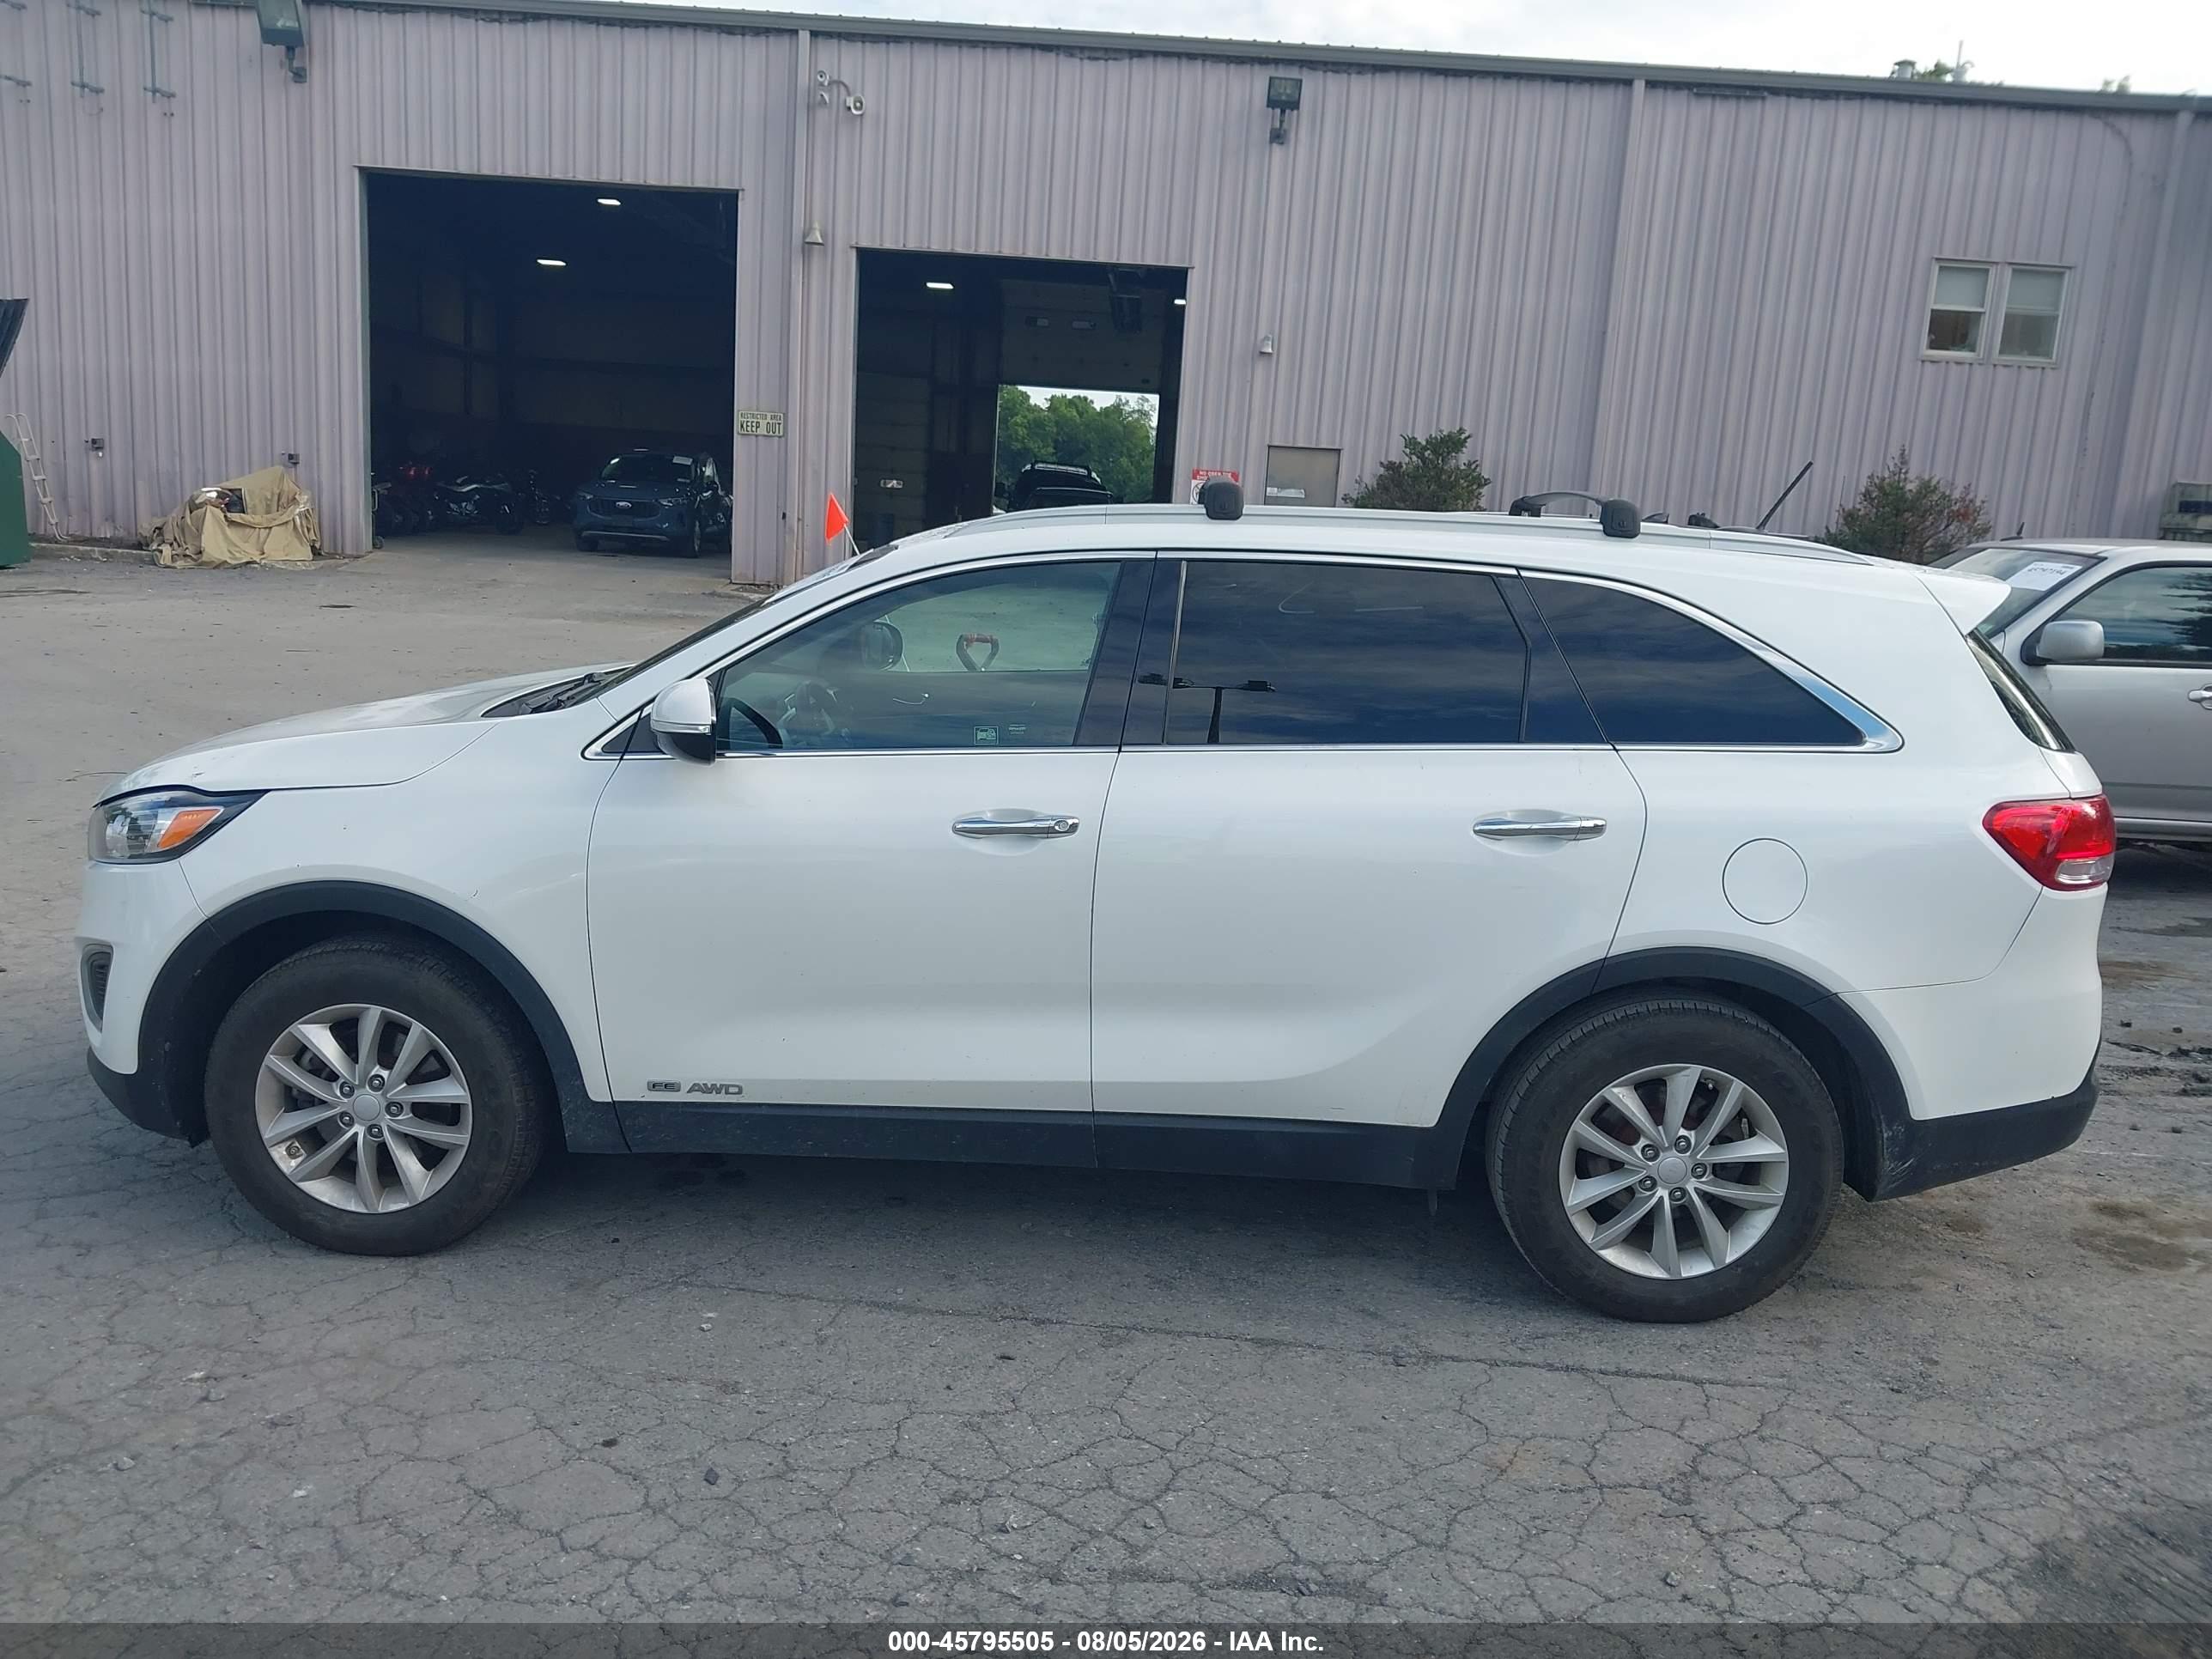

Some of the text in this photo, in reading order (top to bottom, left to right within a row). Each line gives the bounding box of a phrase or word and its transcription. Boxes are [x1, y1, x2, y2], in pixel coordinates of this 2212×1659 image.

[740, 421, 781, 434] KEEP OUT
[686, 1083, 743, 1095] AWD
